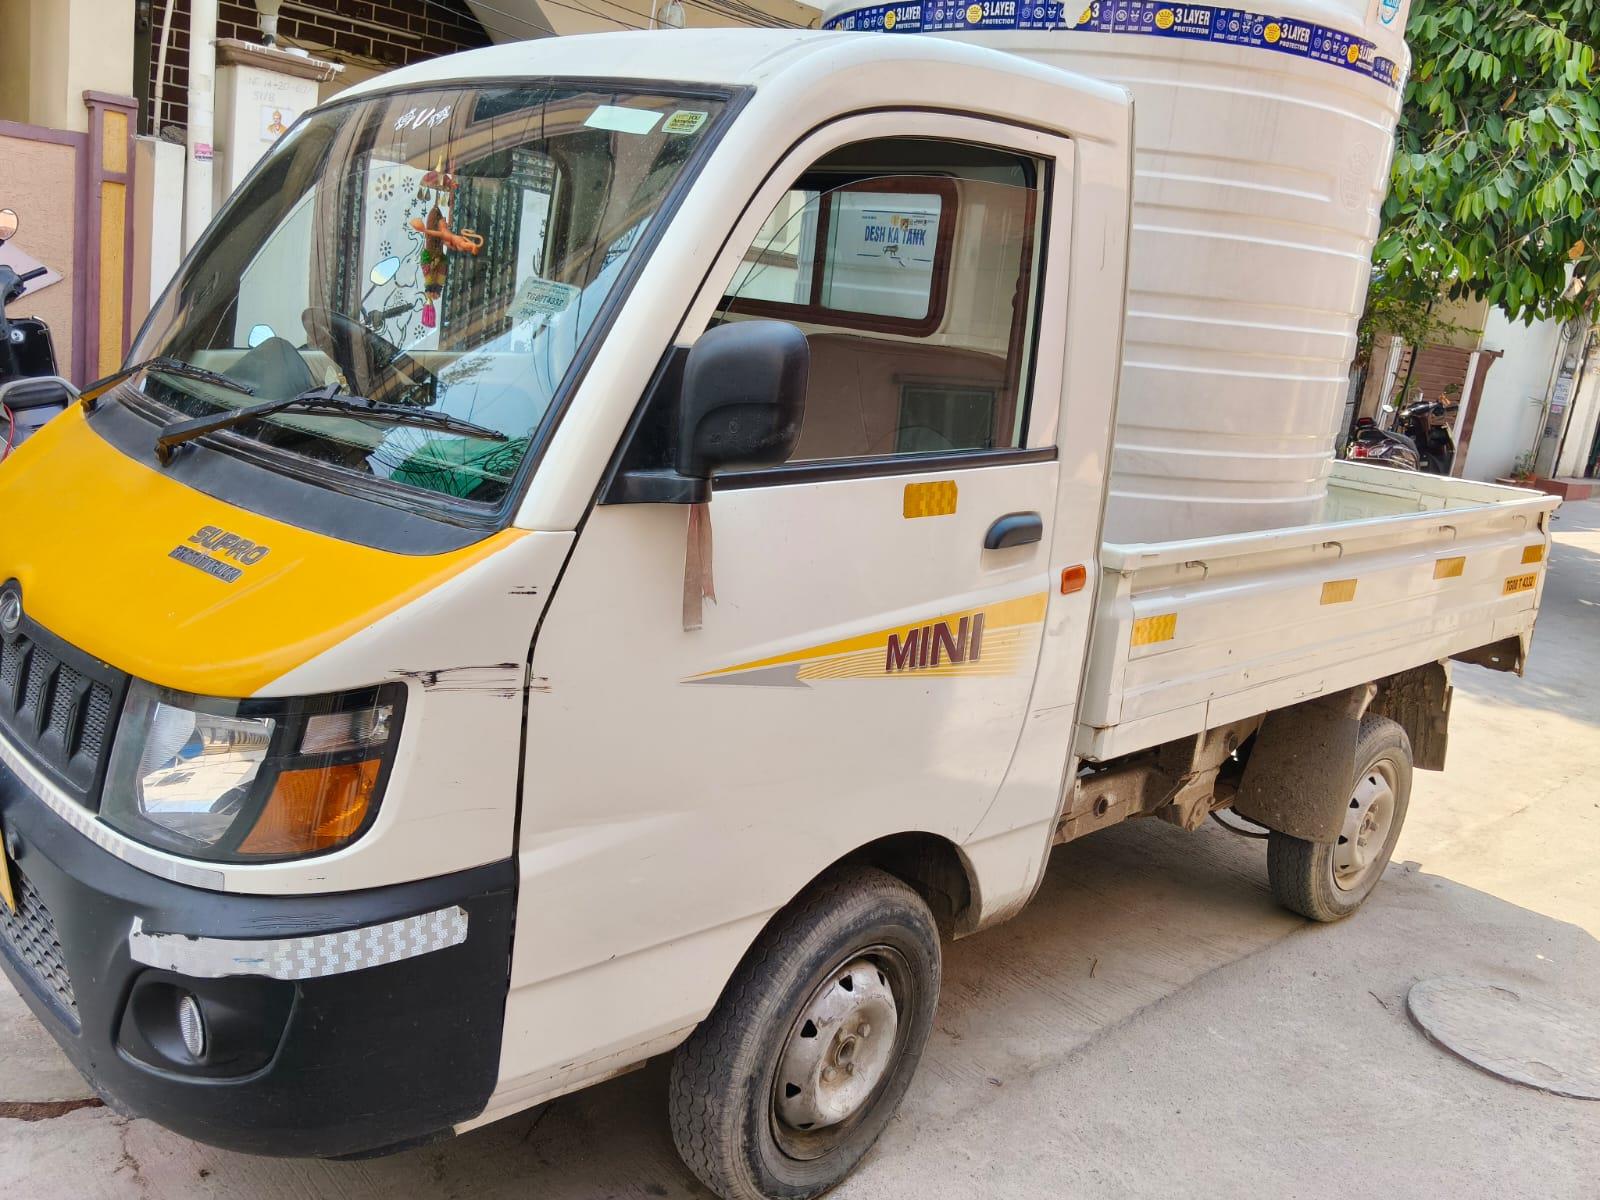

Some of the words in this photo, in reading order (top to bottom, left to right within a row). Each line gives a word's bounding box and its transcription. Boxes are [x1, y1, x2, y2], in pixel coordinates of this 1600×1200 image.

[897, 8, 903, 21] 3
[902, 6, 921, 20] LAYER
[983, 1, 990, 16] 3
[990, 1, 1016, 16] LAYER
[1092, 2, 1100, 18] 3
[1175, 8, 1182, 23] 3
[1184, 9, 1211, 26] LAYER
[1173, 25, 1209, 35] PROTECTION
[1280, 23, 1288, 39] 3
[1288, 24, 1311, 43] LAYER
[1279, 40, 1308, 52] PROTECTION
[864, 225, 886, 242] DESH
[887, 226, 899, 244] KA
[902, 228, 926, 246] TANK
[187, 525, 270, 566] SUPRO
[886, 612, 984, 671] MINI
